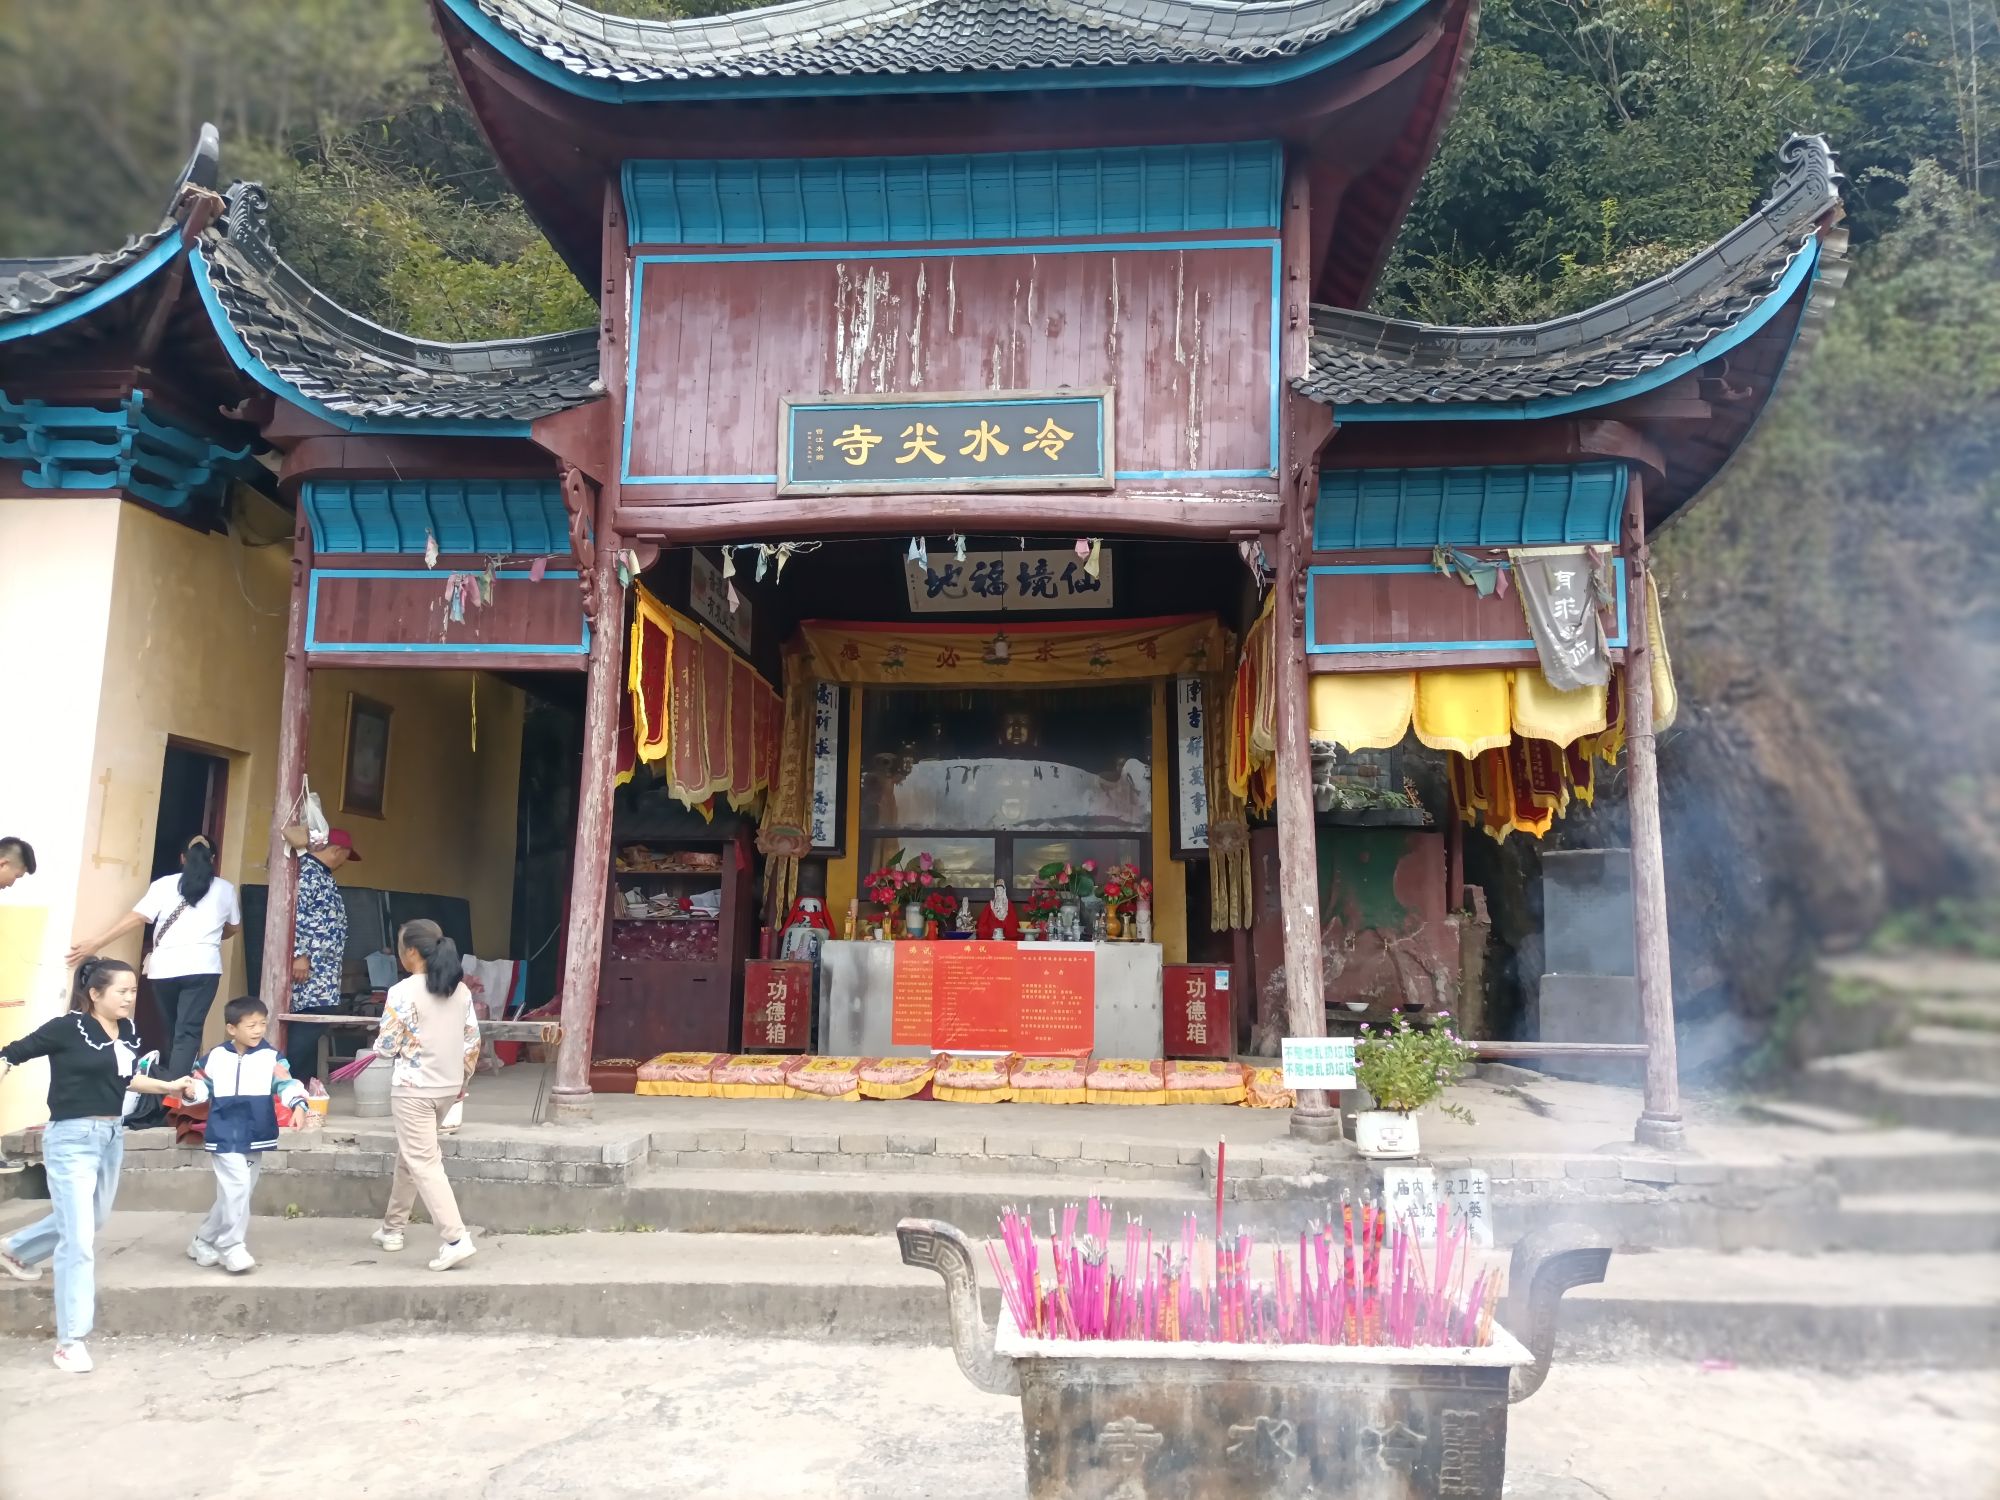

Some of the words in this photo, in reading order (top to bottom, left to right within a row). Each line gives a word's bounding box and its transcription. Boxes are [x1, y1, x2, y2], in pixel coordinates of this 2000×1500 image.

[765, 980, 788, 1045] 功德箱
[1186, 977, 1207, 1045] 功德箱
